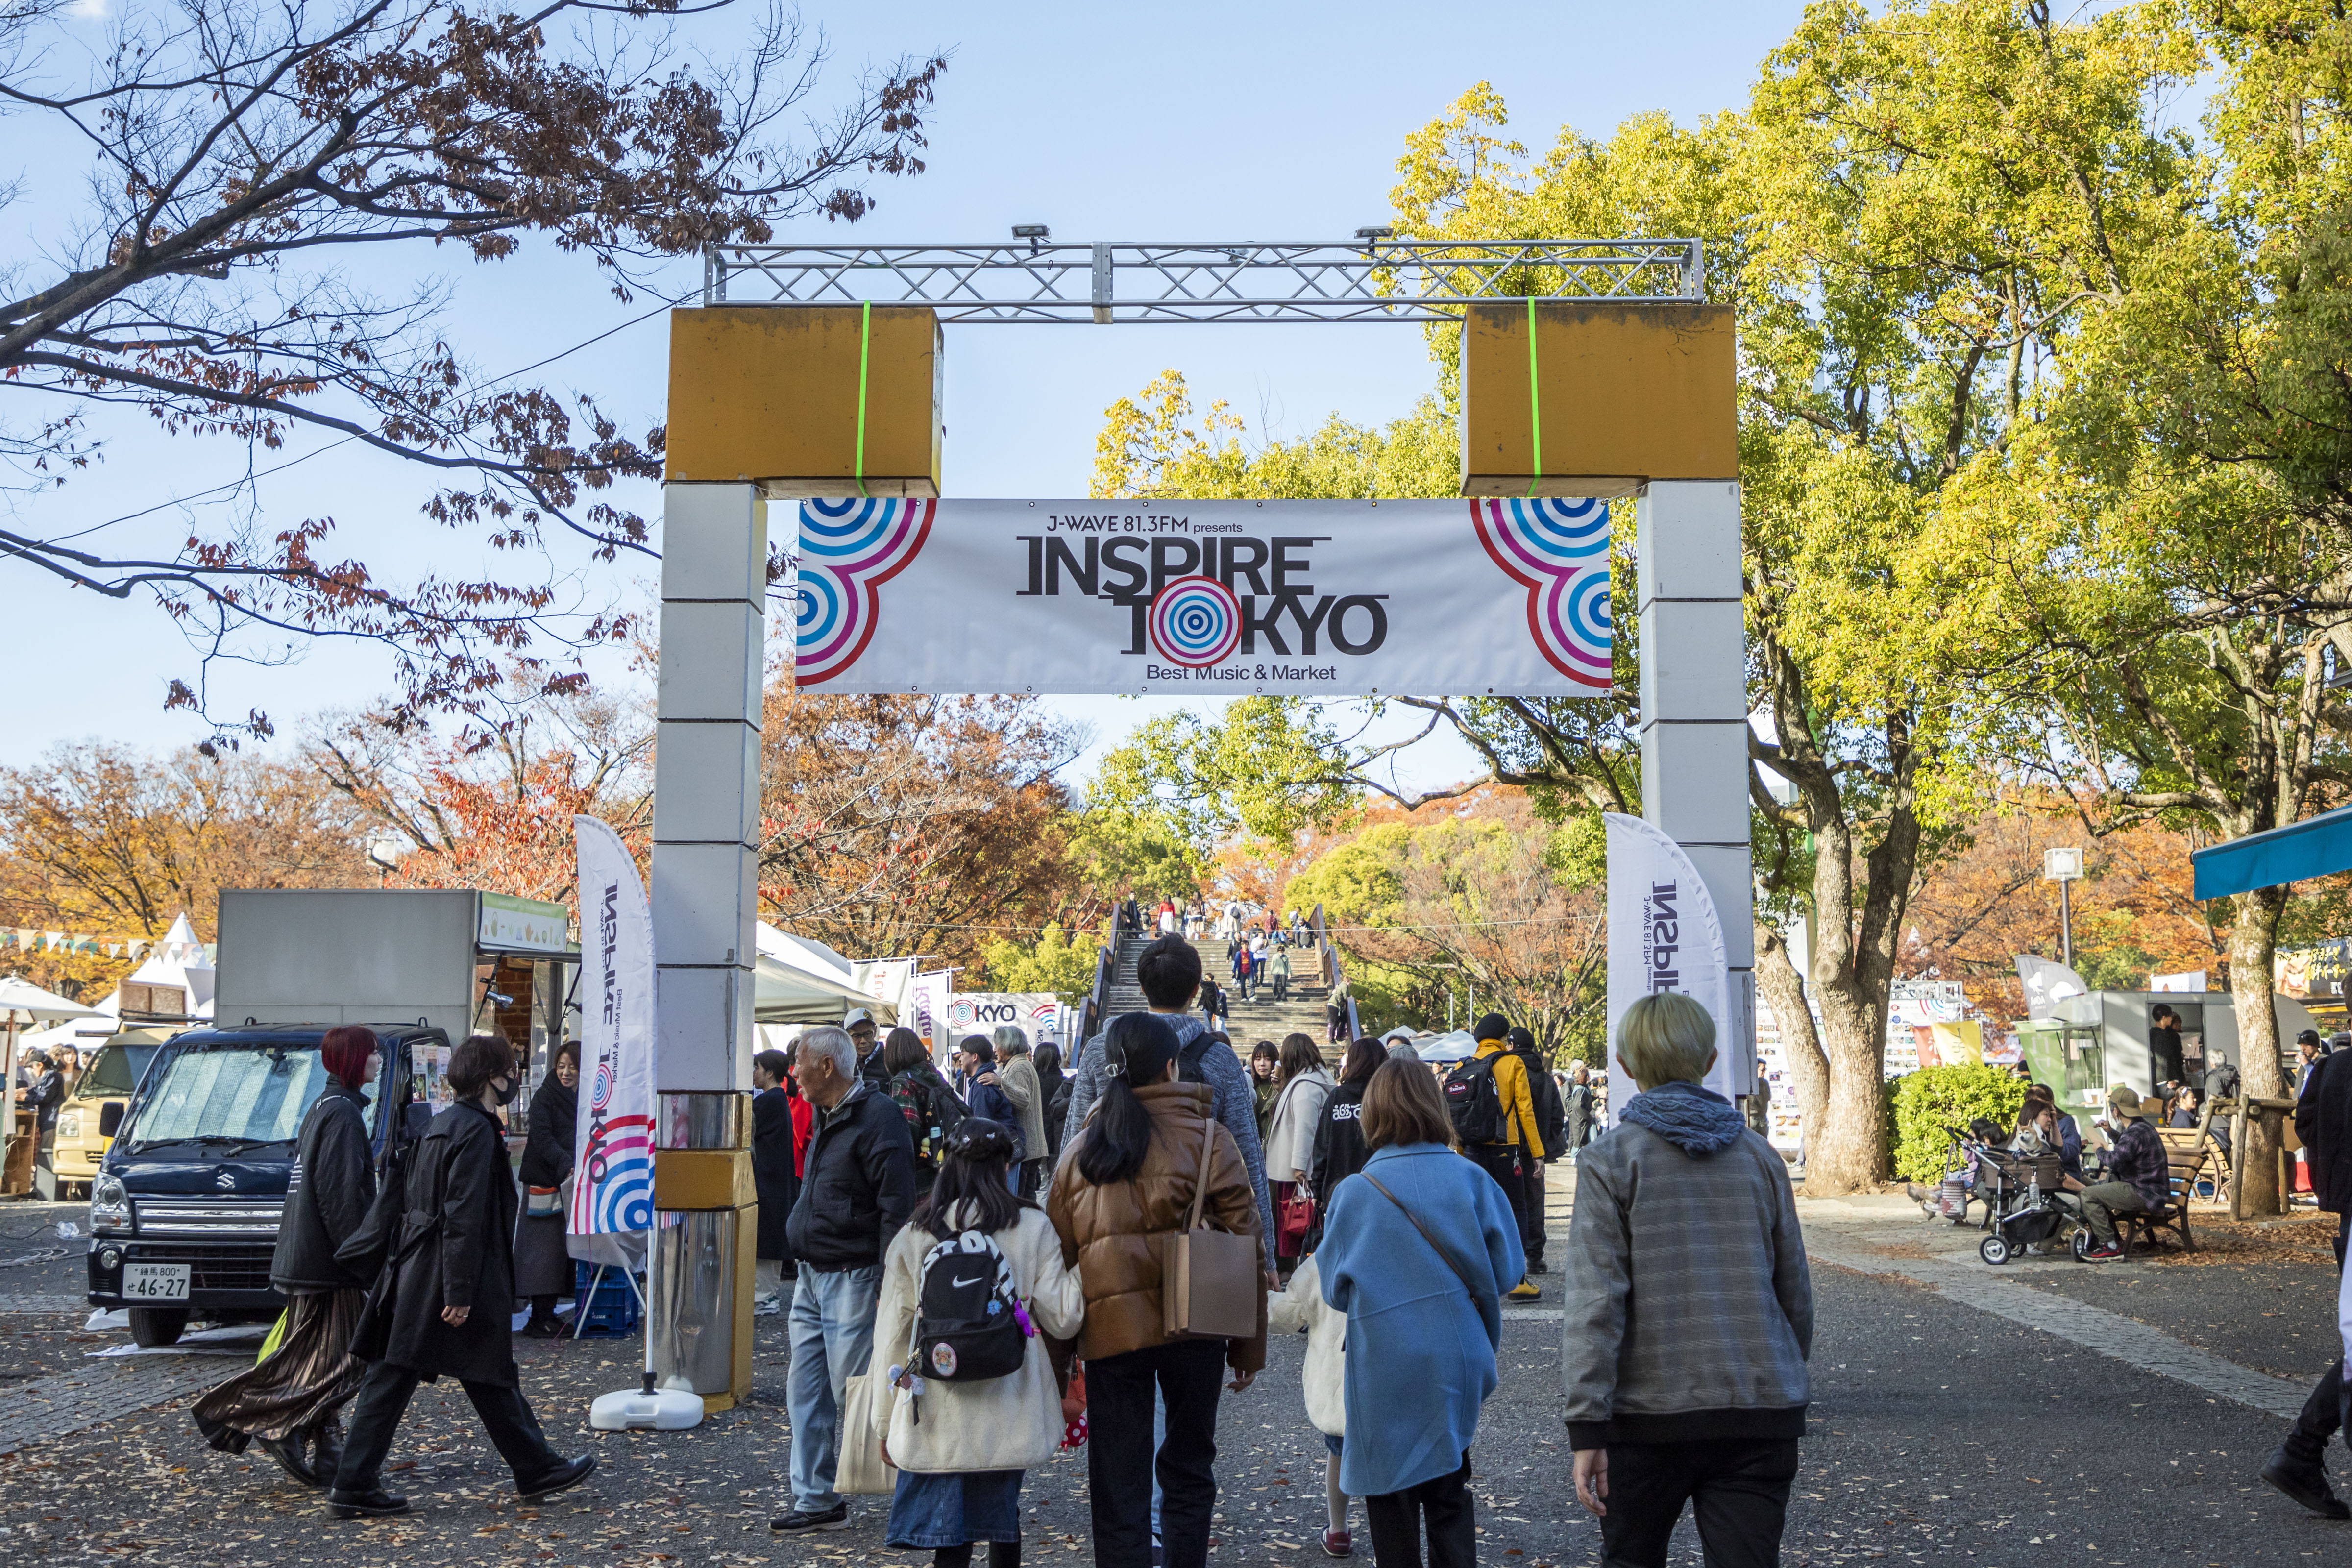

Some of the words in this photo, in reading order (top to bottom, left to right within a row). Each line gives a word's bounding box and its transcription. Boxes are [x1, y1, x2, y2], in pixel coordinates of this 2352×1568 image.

[1047, 515, 1119, 532] J-WAVE
[1124, 516, 1188, 532] 81.3FM
[1193, 523, 1243, 535] presents
[1016, 535, 1332, 596] INSPIRE
[1098, 576, 1390, 667] TOKYO
[1147, 664, 1189, 680] Best
[1195, 664, 1250, 680] Music
[1254, 664, 1268, 680] &
[1272, 665, 1336, 680] Market
[140, 1267, 158, 1276] 練馬
[160, 1267, 176, 1276] 800
[127, 1282, 136, 1292] せ
[138, 1278, 186, 1297] 46-27
